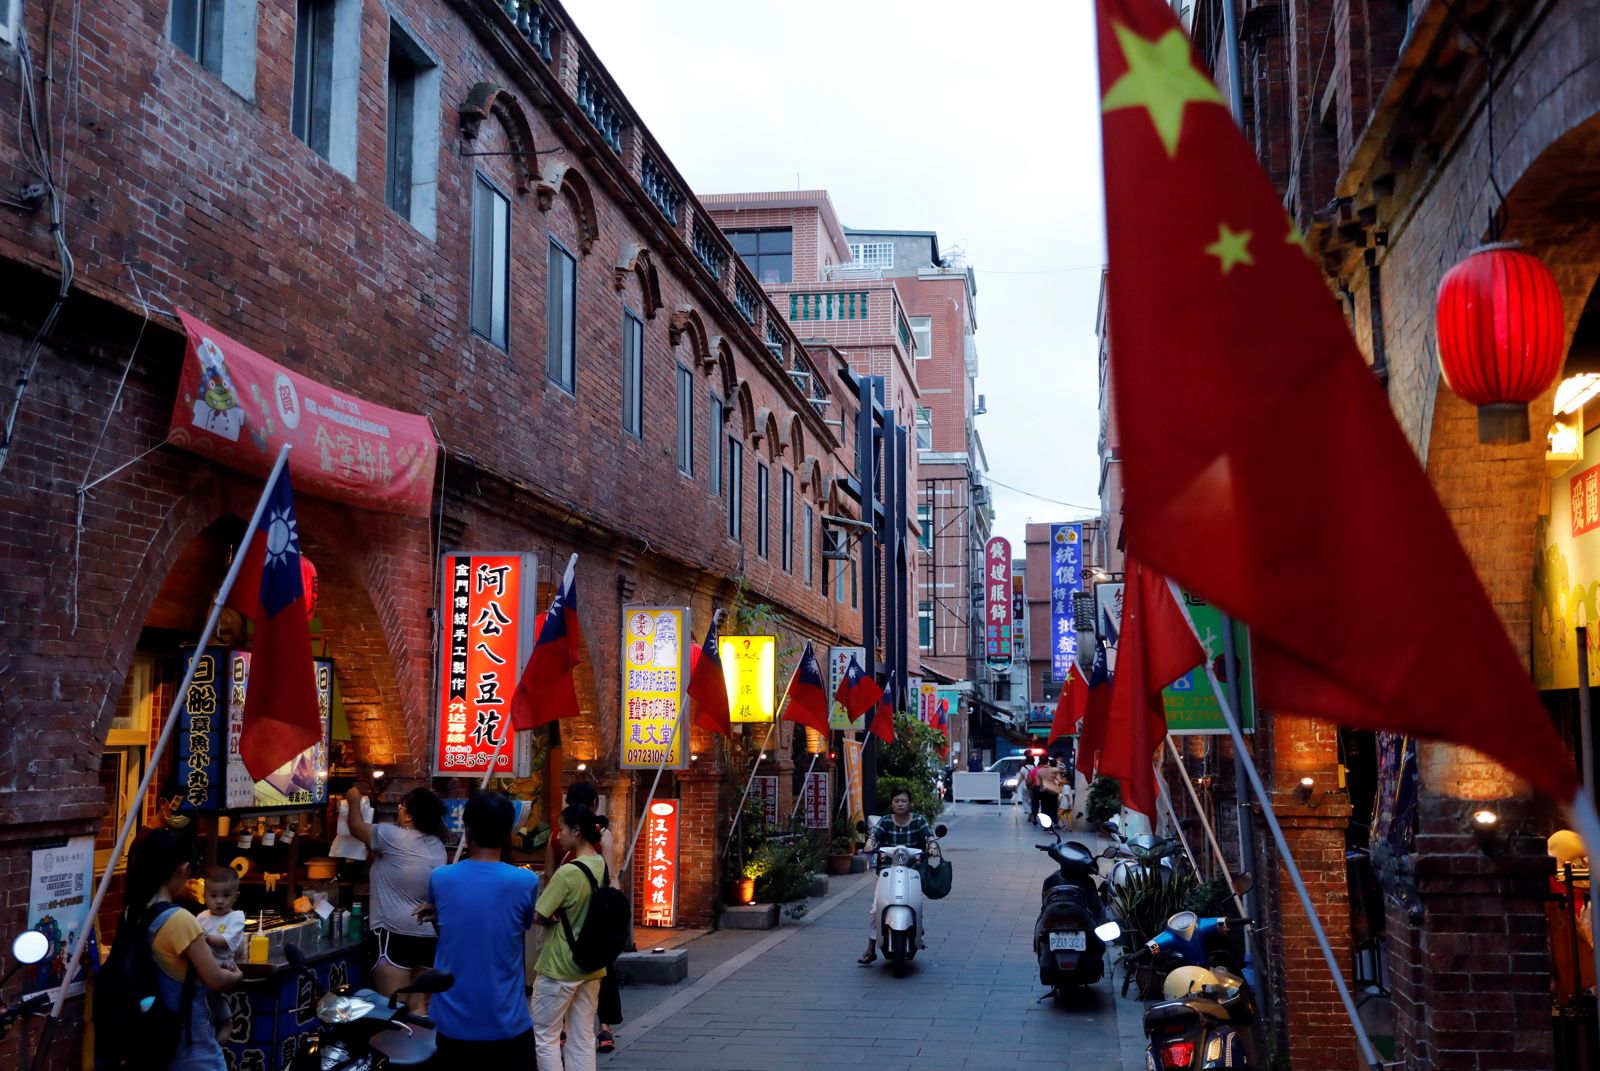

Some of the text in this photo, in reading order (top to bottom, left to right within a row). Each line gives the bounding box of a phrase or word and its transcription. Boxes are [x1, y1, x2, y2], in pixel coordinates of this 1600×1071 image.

[451, 564, 470, 690] 金門傳統手工製作
